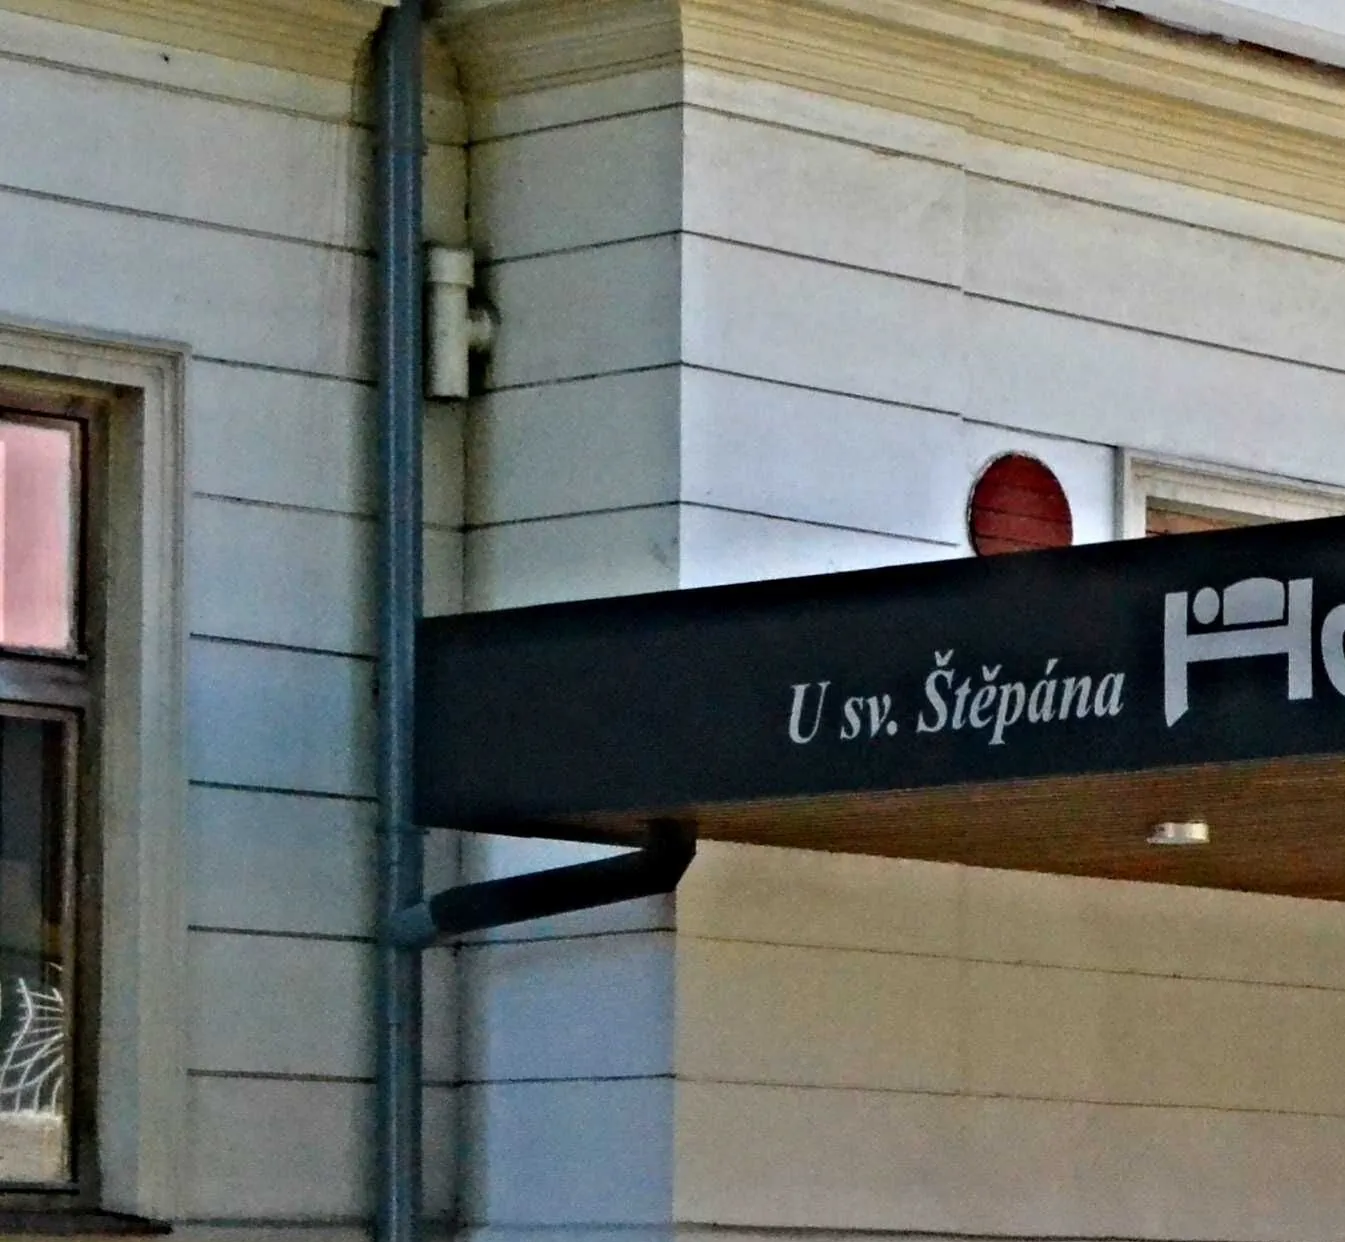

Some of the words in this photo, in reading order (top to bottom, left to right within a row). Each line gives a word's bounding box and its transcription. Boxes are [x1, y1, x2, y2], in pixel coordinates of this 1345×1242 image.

[788, 680, 831, 744] U
[839, 695, 899, 740] sv.
[916, 649, 1126, 746] Štěpána
